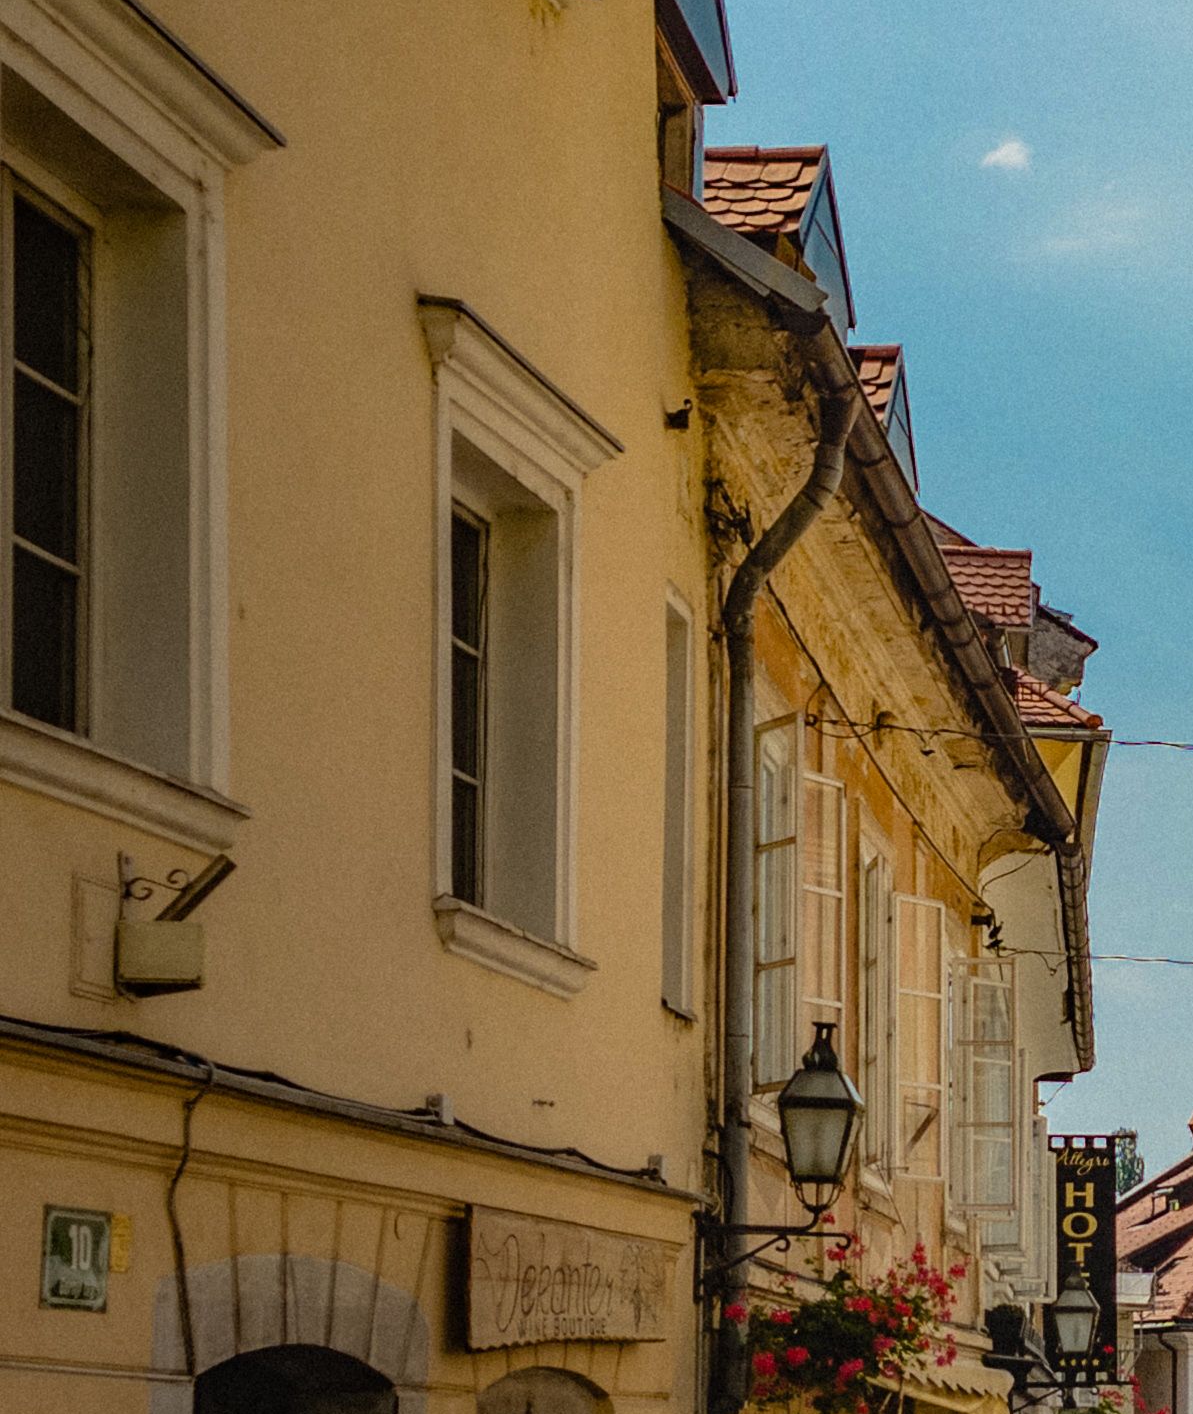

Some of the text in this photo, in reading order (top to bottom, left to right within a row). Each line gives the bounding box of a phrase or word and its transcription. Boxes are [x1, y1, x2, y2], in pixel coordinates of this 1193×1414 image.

[1057, 1148, 1110, 1176] Allegro
[68, 1223, 93, 1271] 10
[518, 1317, 607, 1336] WINE BOUTIQUE
